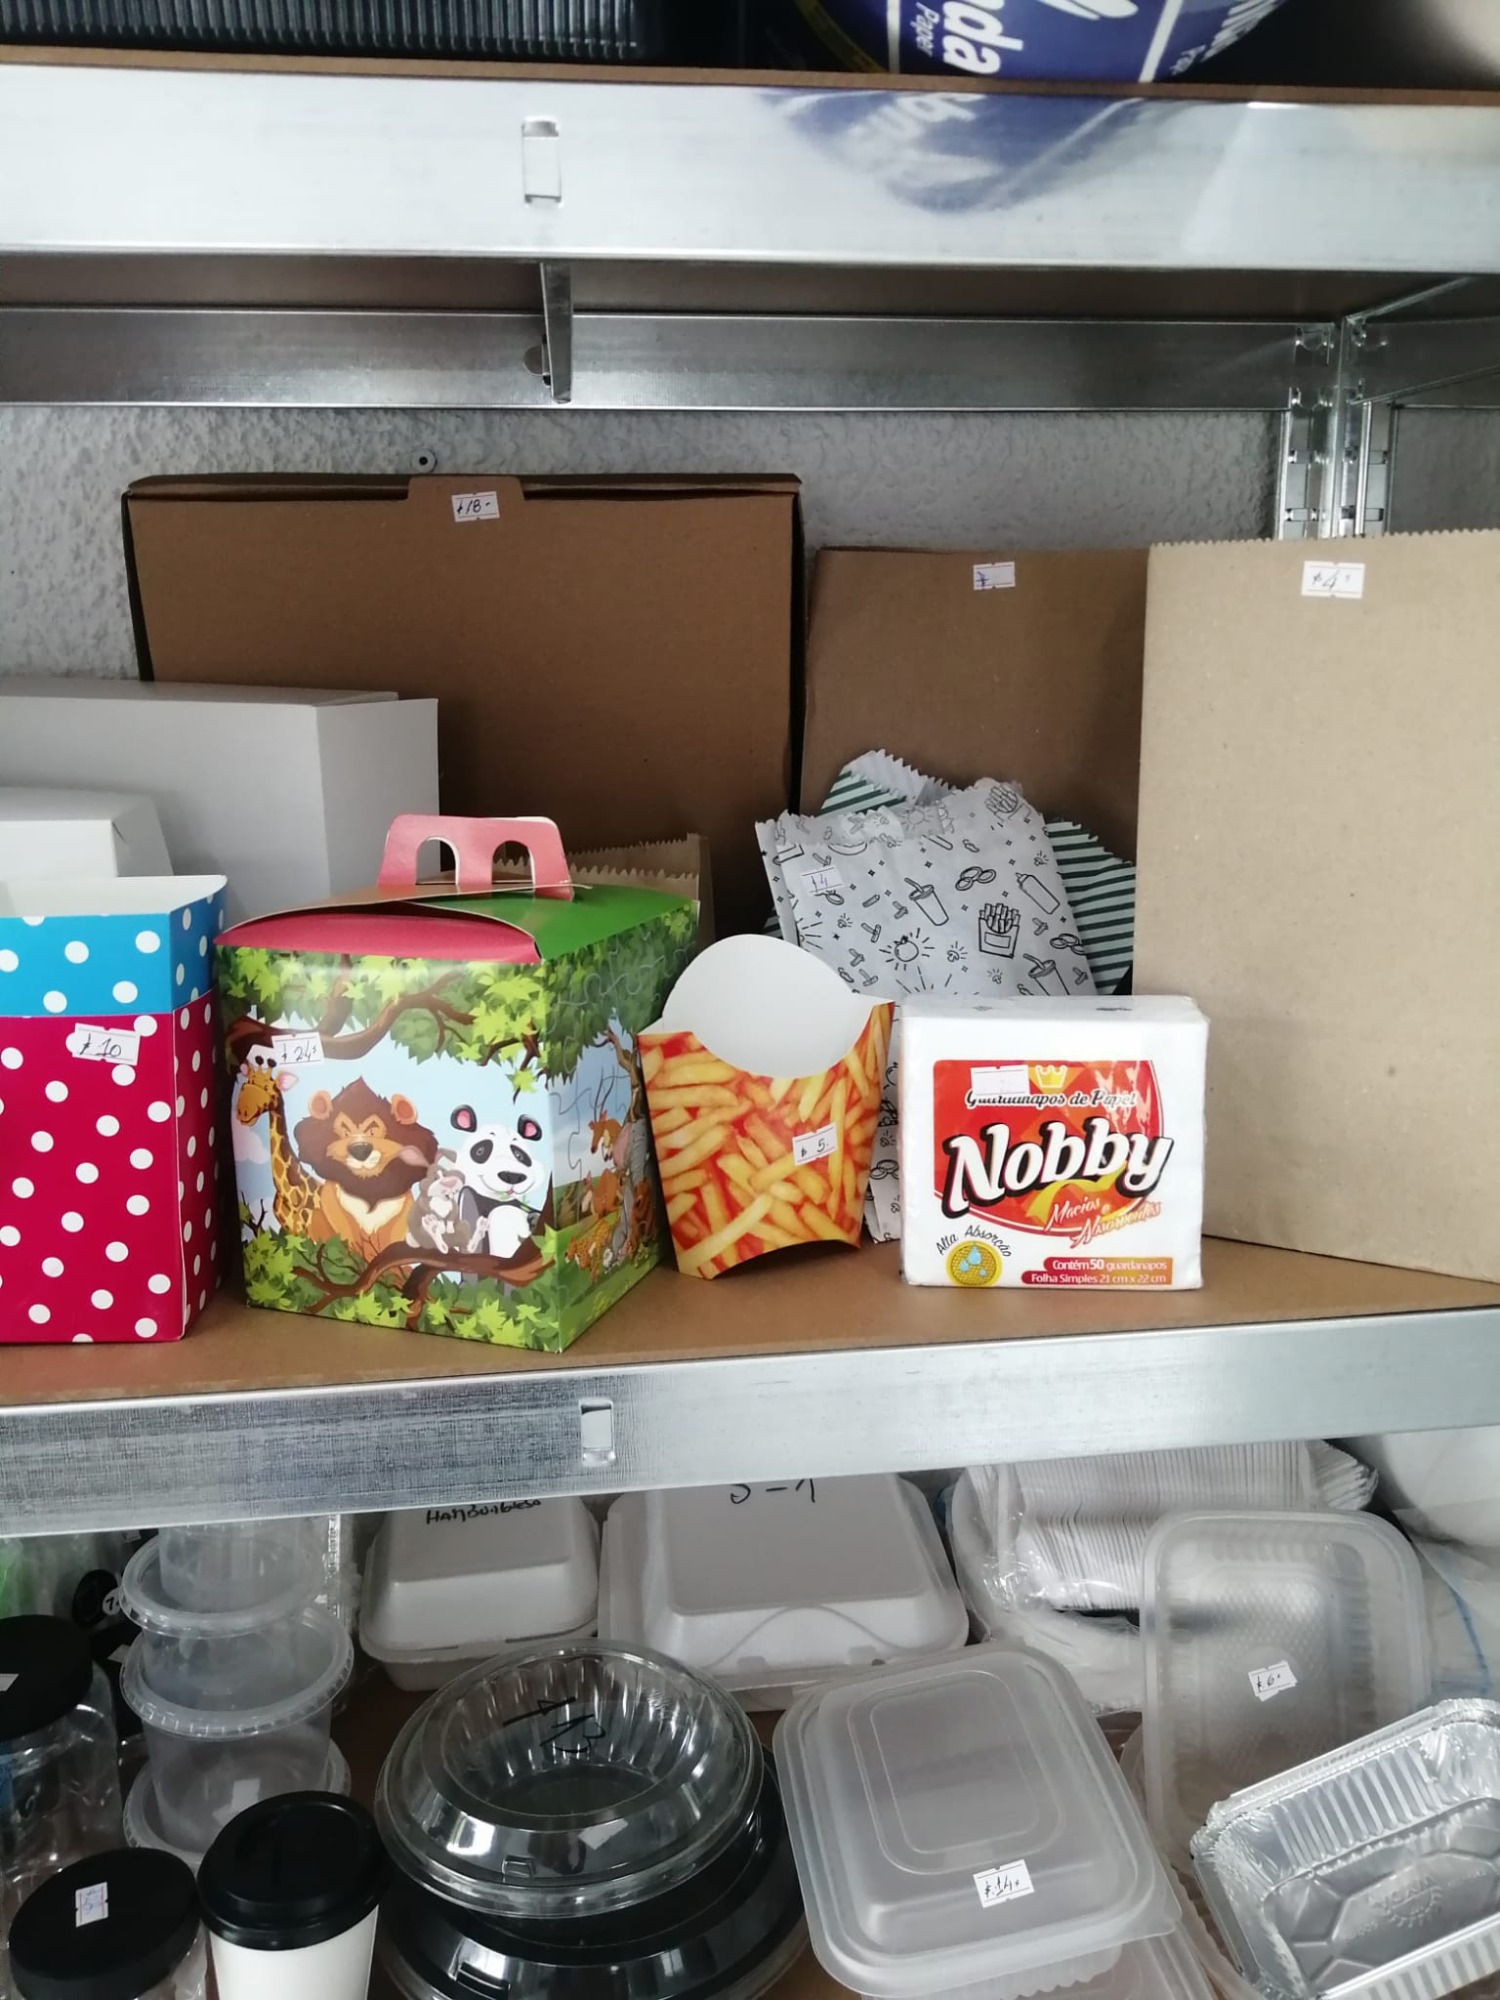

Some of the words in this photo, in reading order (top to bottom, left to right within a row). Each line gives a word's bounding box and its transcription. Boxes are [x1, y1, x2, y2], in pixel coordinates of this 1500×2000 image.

[915, 2, 937, 57] Paper
[1069, 1092, 1087, 1105] de
[1091, 1089, 1136, 1109] Papel
[941, 1116, 1174, 1219] Nobby
[1044, 1197, 1100, 1232] Macios
[1101, 1203, 1111, 1214] e
[936, 1234, 958, 1255] Alta
[1052, 1259, 1089, 1271] Contém
[1089, 1258, 1104, 1271] 50
[1106, 1261, 1167, 1272] guardanapos
[1031, 1273, 1058, 1283] Folha
[1060, 1273, 1098, 1284] Simples
[1100, 1274, 1110, 1283] 21
[1137, 1274, 1149, 1283] 22
[1151, 1275, 1167, 1283] cm
